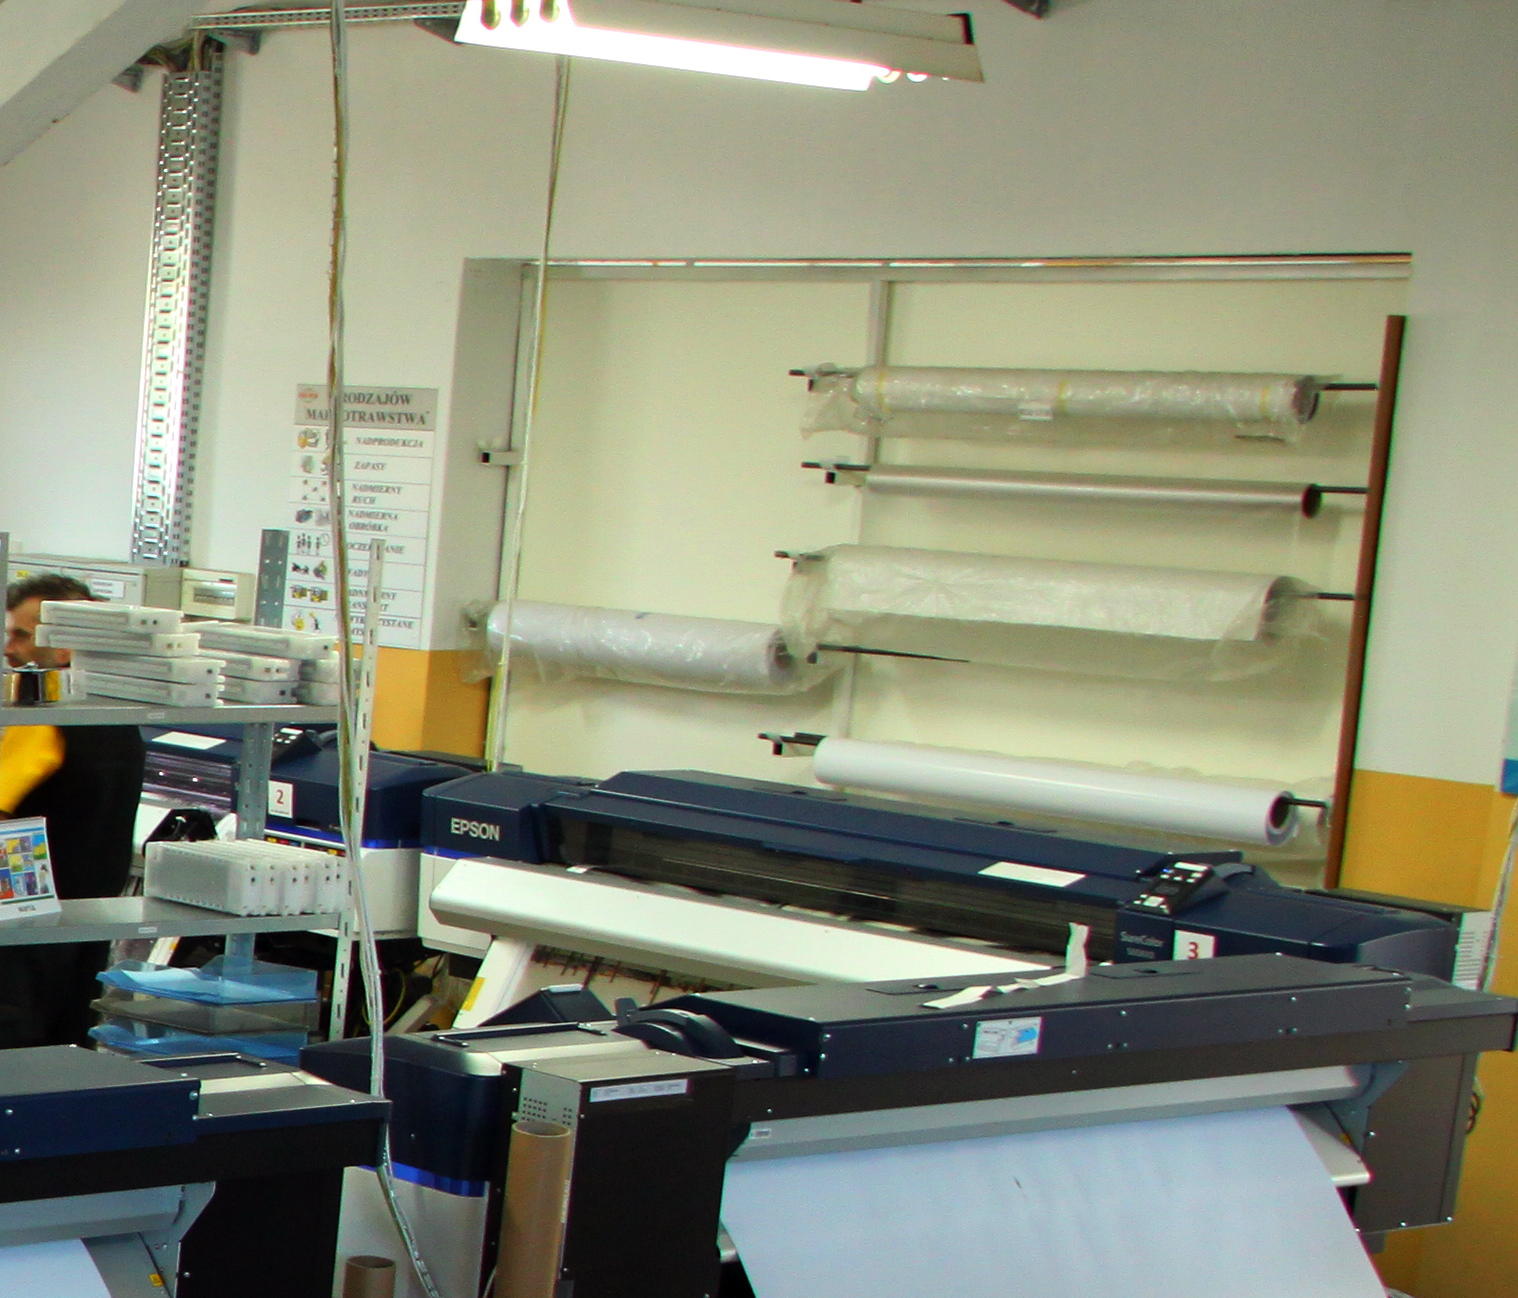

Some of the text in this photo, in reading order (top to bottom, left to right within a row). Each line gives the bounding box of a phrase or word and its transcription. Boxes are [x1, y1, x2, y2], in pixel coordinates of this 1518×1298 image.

[276, 789, 285, 805] 2
[451, 817, 500, 842] EPSON
[1187, 941, 1199, 960] 3
